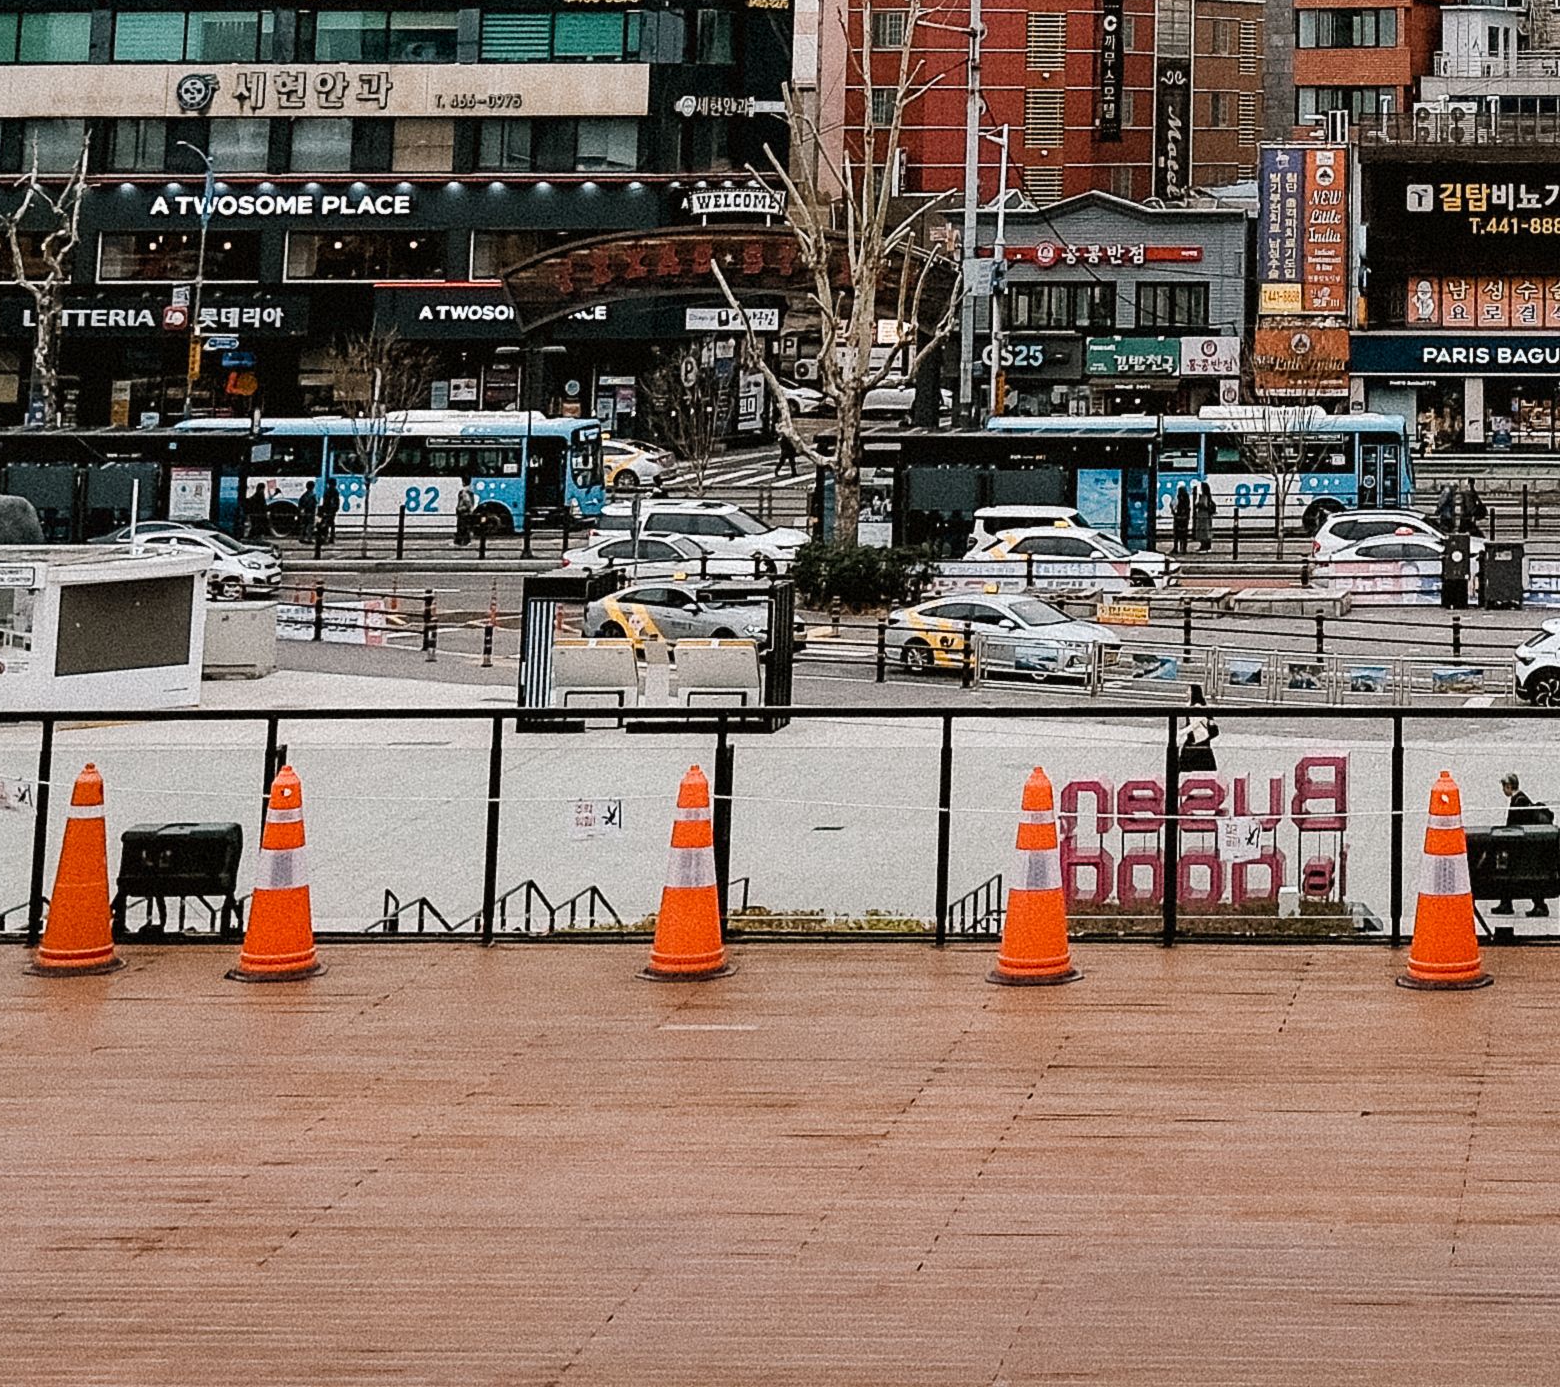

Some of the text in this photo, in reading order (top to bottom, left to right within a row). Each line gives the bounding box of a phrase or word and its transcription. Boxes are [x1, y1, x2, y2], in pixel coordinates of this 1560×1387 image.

[232, 71, 394, 109] 세현안과
[149, 195, 411, 216] A TWOSOME PLACE
[696, 193, 778, 210] WELCOME
[1309, 189, 1343, 206] NEW
[1308, 227, 1342, 243] India
[1061, 243, 1146, 266] 홍콩반점
[22, 307, 285, 328] LTTERIA 롯데리아
[418, 305, 435, 321] A
[982, 344, 1044, 367] GS25
[1113, 354, 1175, 373] 김밥천국
[1422, 346, 1490, 364] PARIS
[403, 486, 440, 513] 82
[1234, 483, 1272, 509] 87
